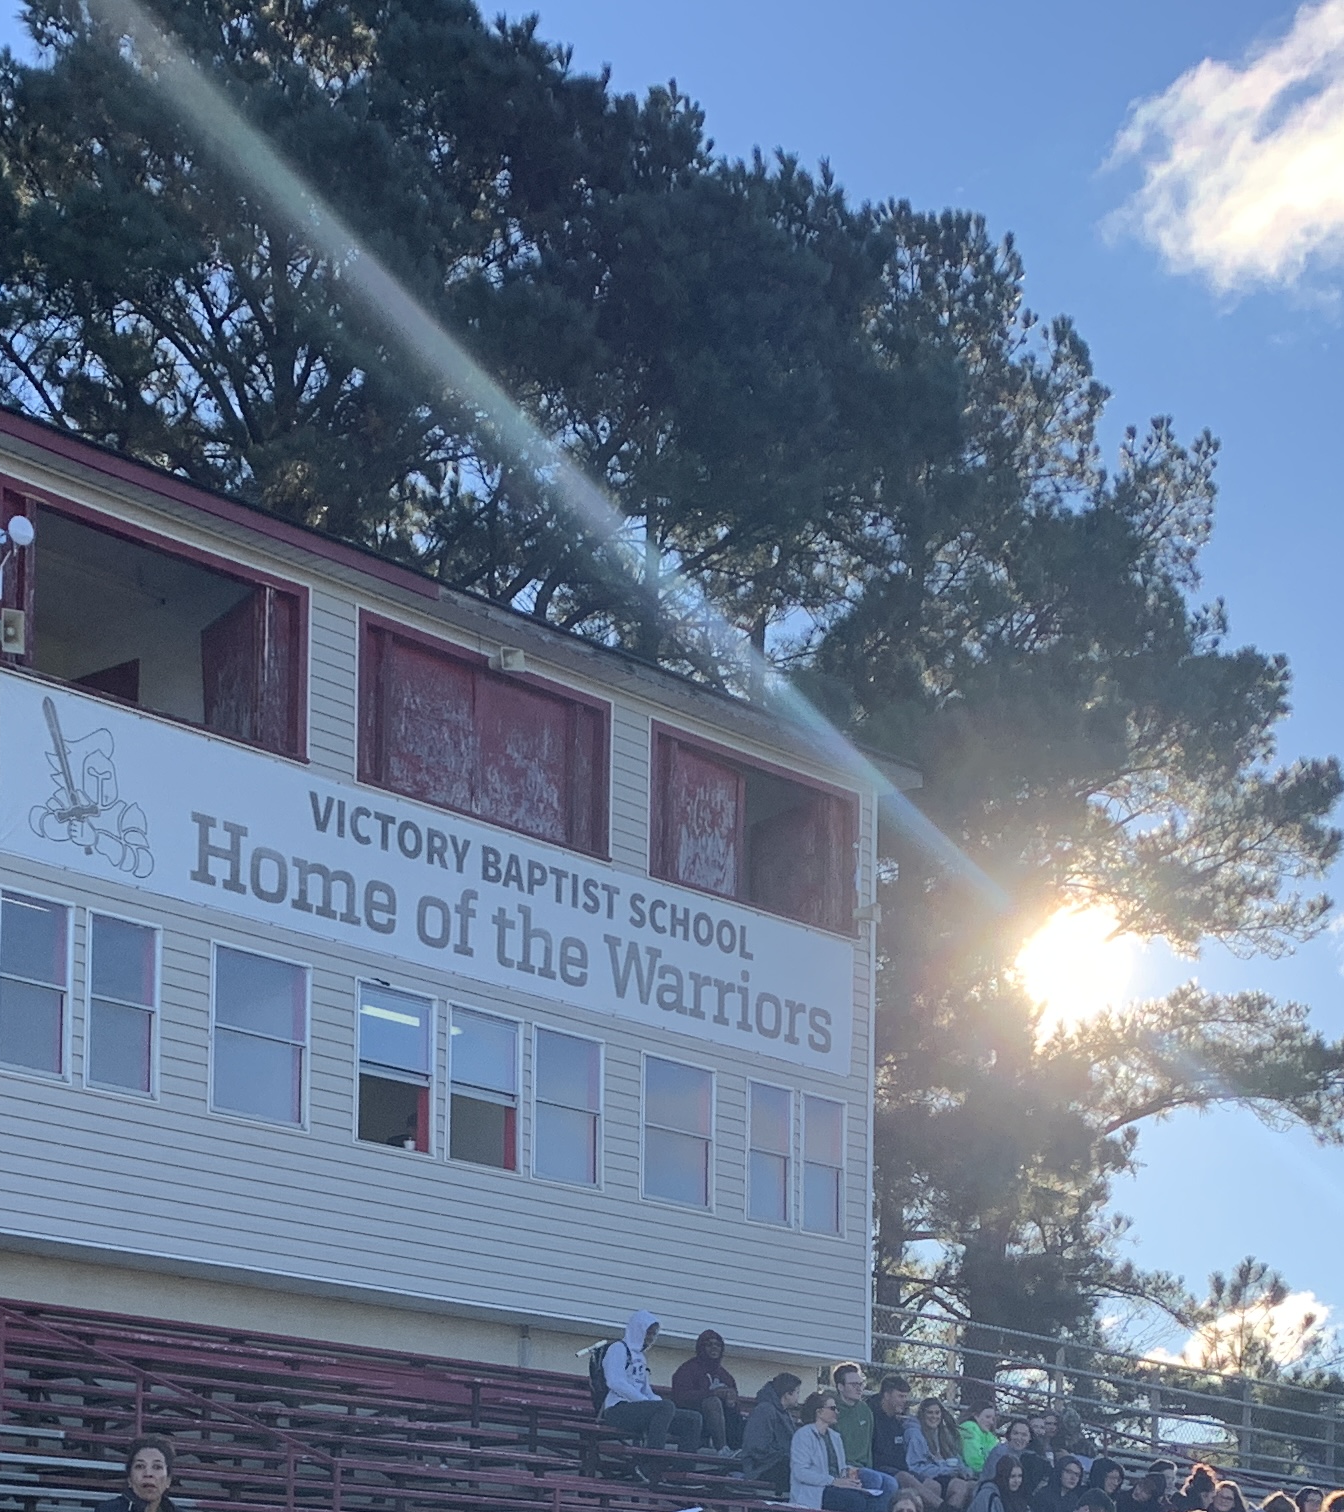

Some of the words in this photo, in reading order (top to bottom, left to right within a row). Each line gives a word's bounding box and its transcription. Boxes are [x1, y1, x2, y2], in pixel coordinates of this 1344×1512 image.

[189, 811, 397, 934] Home
[417, 889, 478, 958] of
[492, 903, 589, 988] the
[602, 934, 833, 1054] Warriors
[309, 791, 471, 873] VICTORY
[481, 844, 620, 920] BAPTIST
[630, 896, 755, 961] SCHOOL
